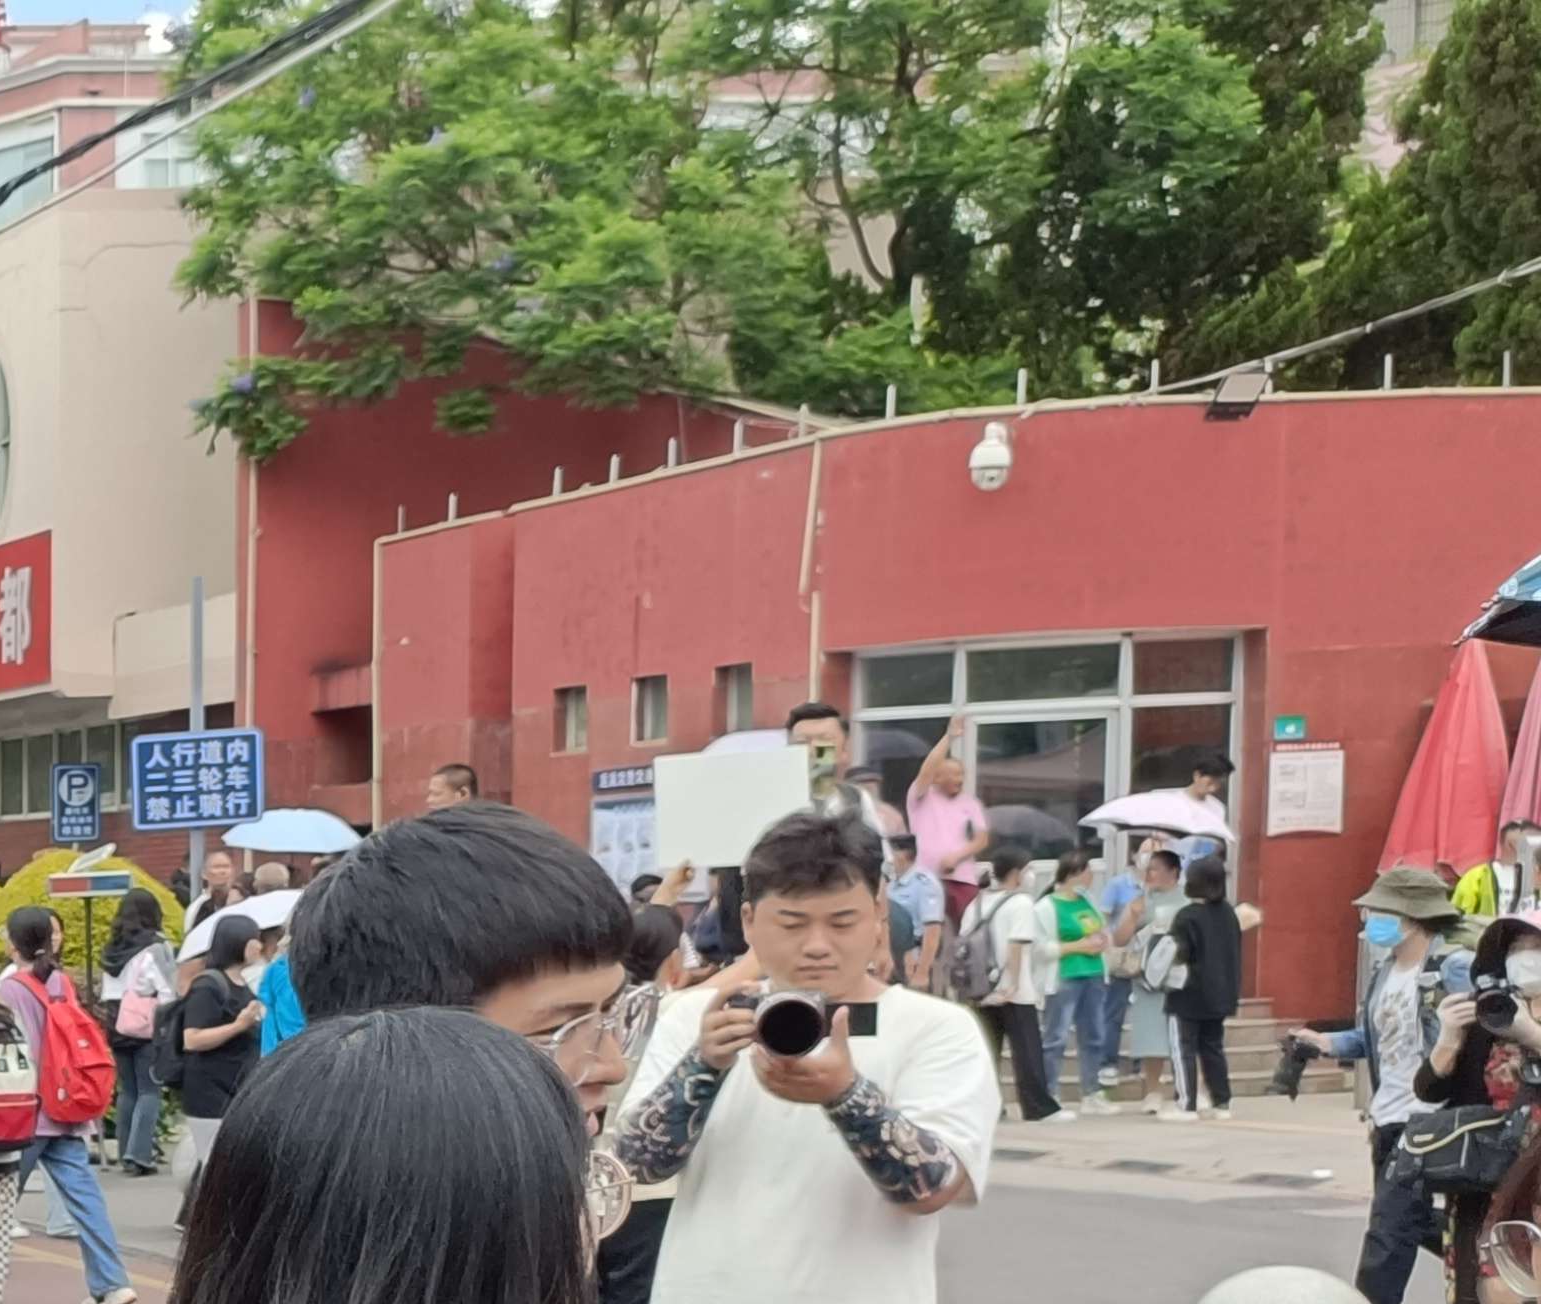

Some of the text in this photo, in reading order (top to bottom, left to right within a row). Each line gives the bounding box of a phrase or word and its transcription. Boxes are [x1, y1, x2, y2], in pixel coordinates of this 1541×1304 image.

[145, 739, 250, 768] 人行道内
[67, 773, 88, 802] P
[144, 765, 250, 792] 二三轮车
[145, 792, 250, 820] 禁止骑行
